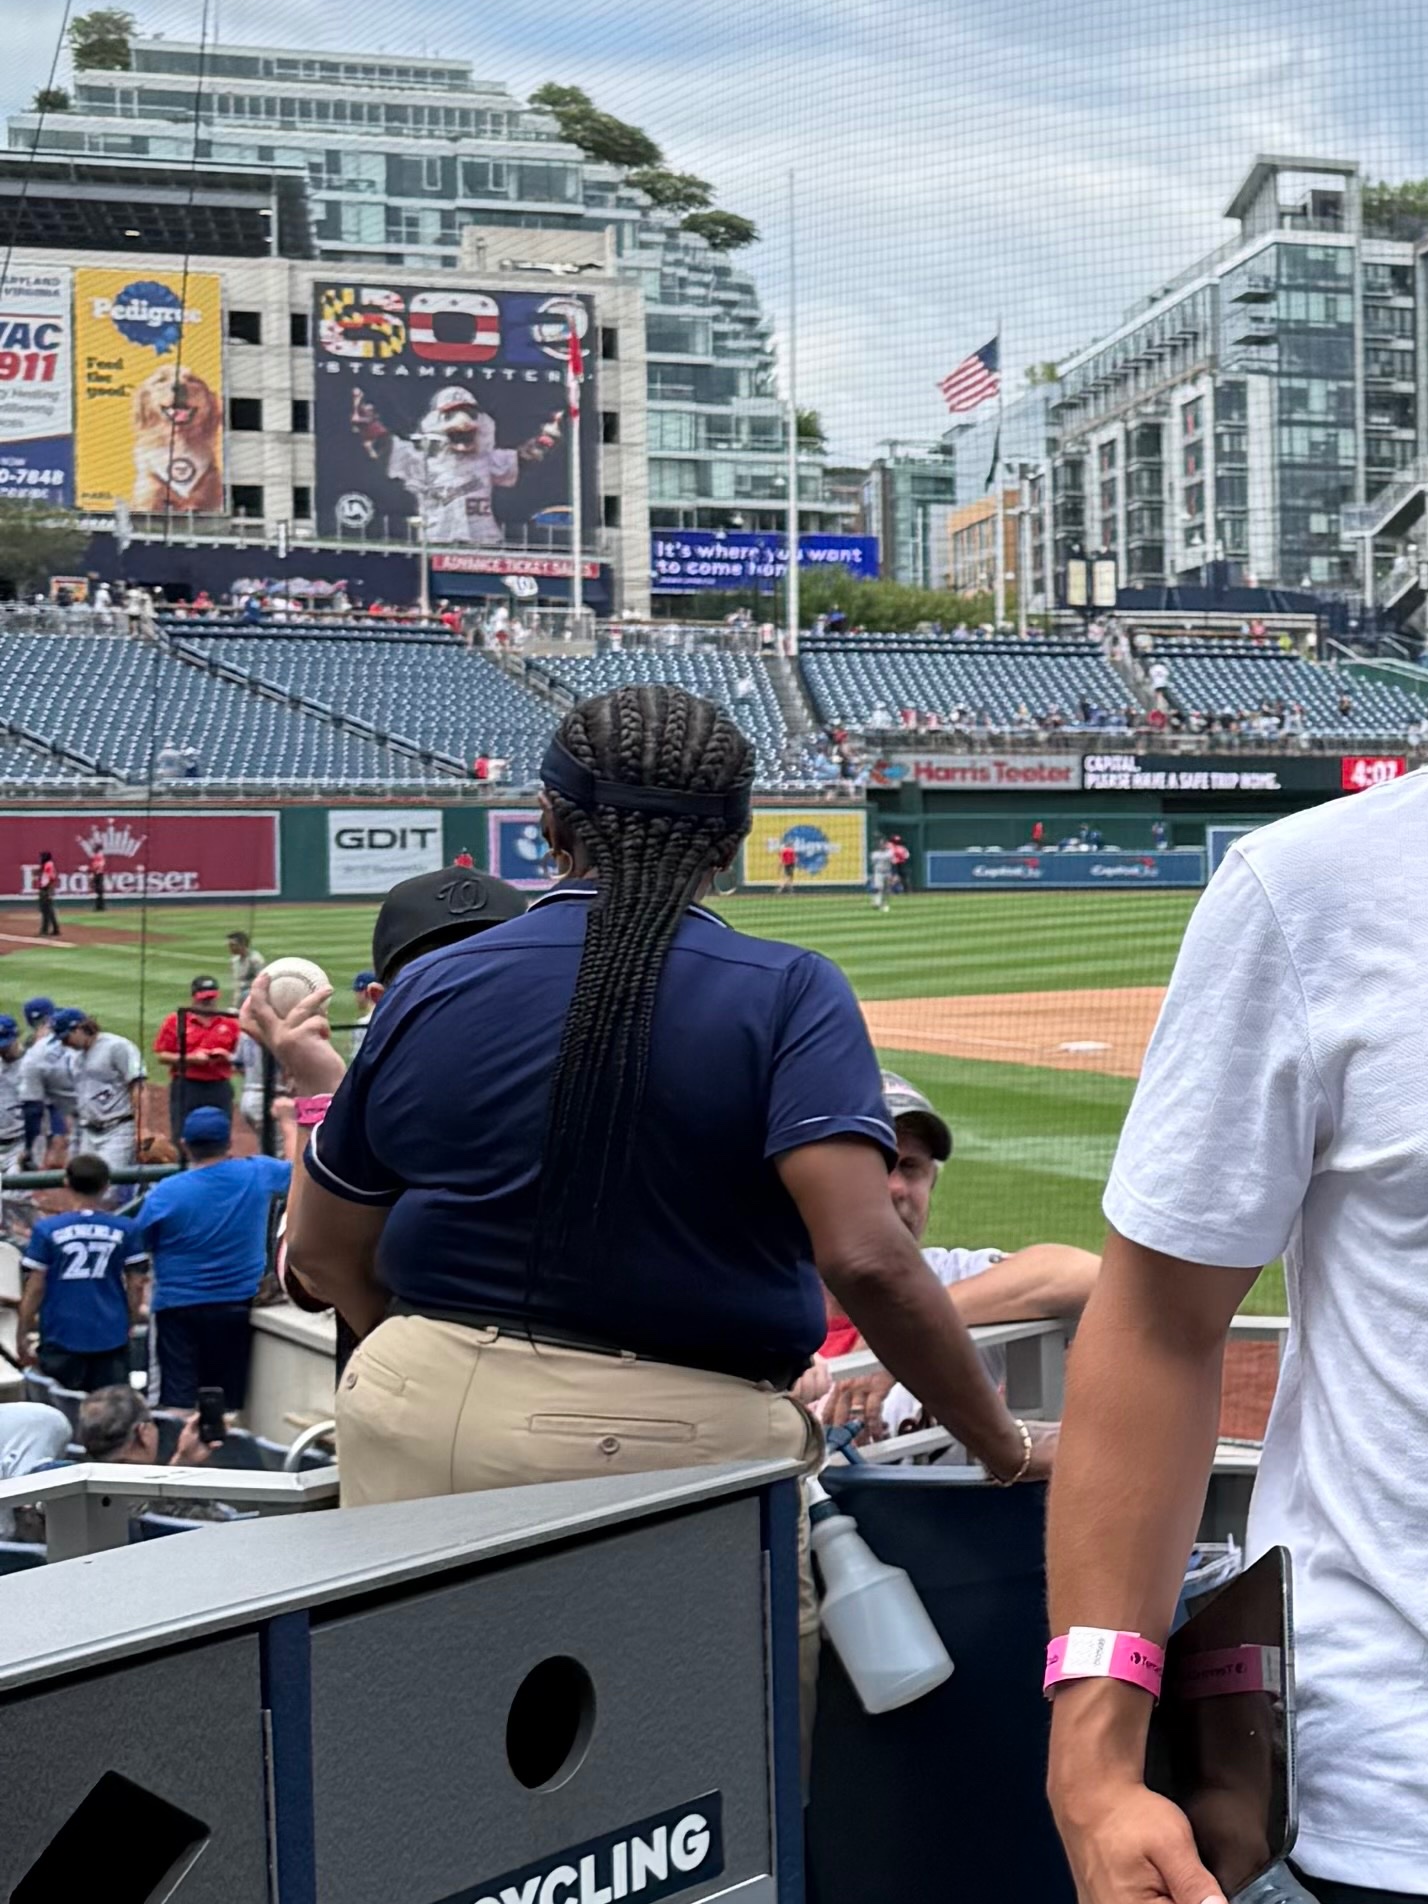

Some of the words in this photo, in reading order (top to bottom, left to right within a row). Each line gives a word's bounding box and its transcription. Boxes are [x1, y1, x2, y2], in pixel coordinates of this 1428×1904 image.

[91, 296, 201, 327] Pedigree
[0, 352, 58, 383] 911
[325, 360, 585, 384] STEAMFITTER
[656, 541, 692, 559] It's
[805, 547, 864, 563] want
[656, 560, 681, 574] to
[686, 562, 743, 576] come
[913, 753, 987, 786] Harris
[989, 754, 1073, 784] Teeter
[1350, 759, 1398, 786] 4:07
[334, 827, 438, 851] GDIT
[61, 1241, 117, 1280] 27
